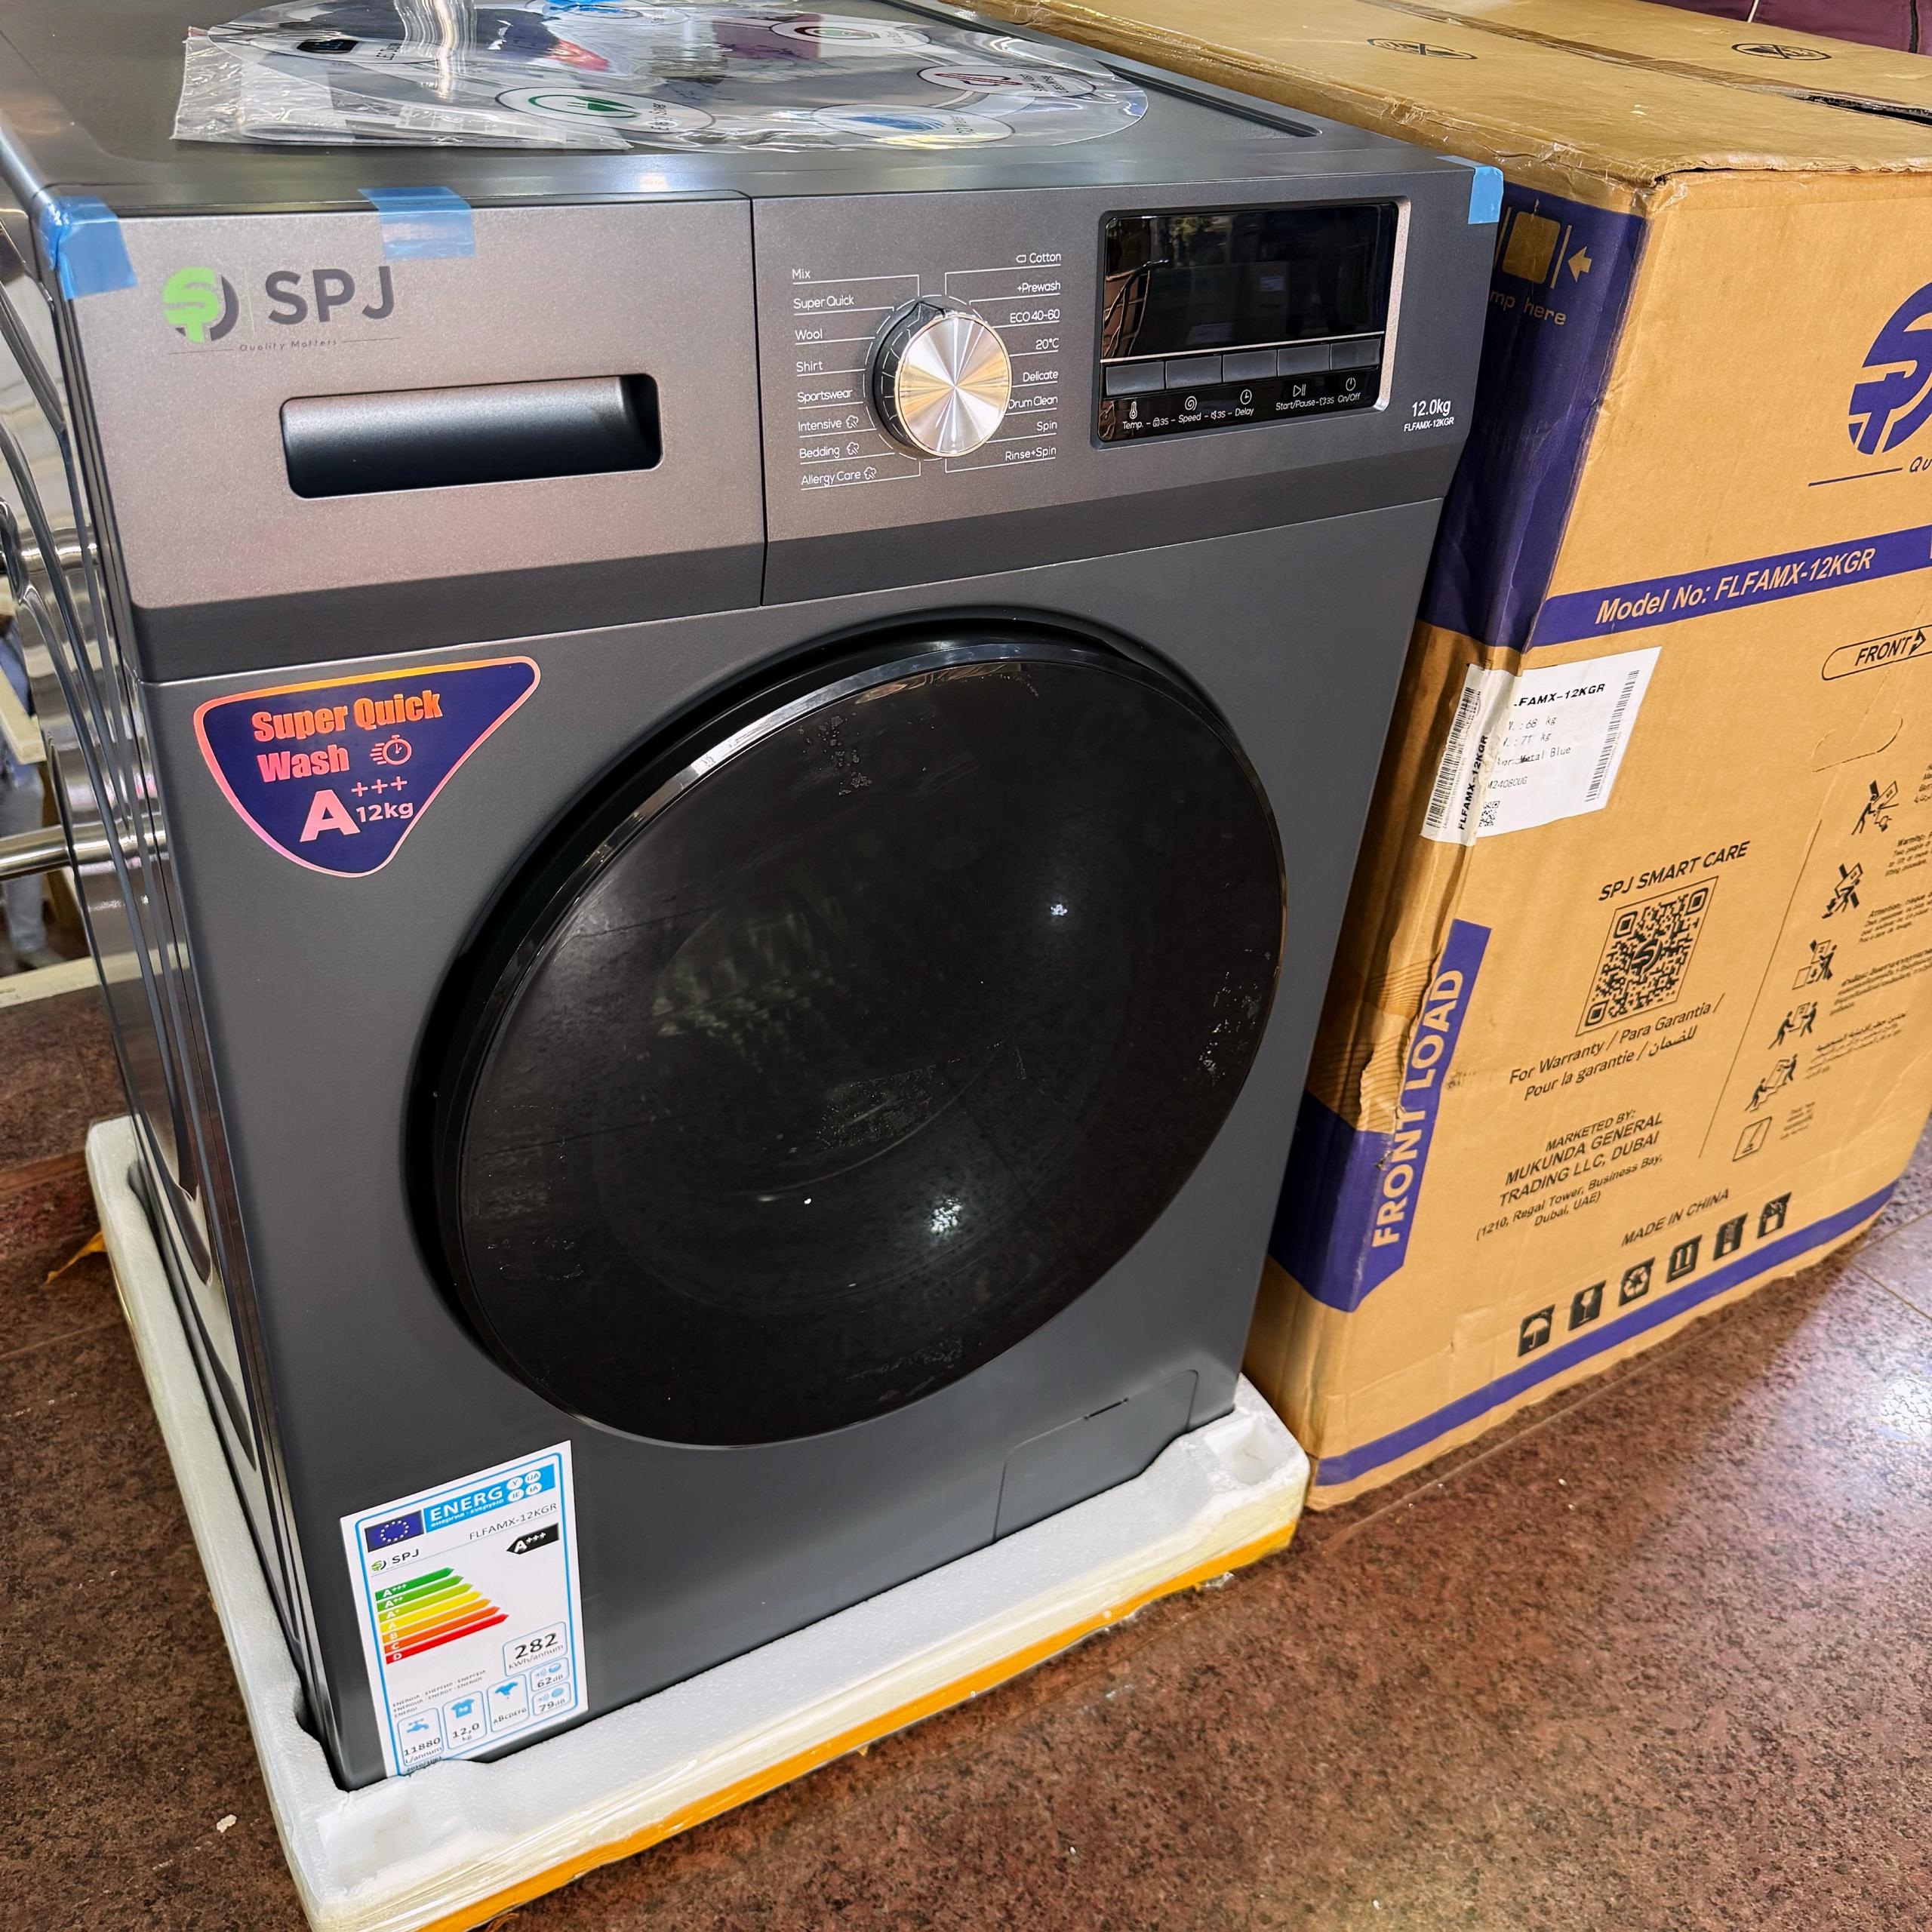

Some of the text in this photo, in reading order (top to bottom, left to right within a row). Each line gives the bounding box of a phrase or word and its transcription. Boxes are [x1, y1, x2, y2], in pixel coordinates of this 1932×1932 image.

[1029, 252, 1061, 263] Cotton
[792, 269, 811, 279] Mix
[265, 265, 395, 325] SPJ
[1017, 281, 1060, 293] +Prewash
[793, 294, 854, 312] Super Quick
[1524, 297, 1567, 326] here
[1010, 309, 1060, 324] ECO 40-60
[795, 328, 823, 340] Wool
[239, 339, 338, 352] Quality Matters
[1035, 338, 1060, 350] 20°C
[796, 361, 823, 373] Shirt
[1023, 371, 1059, 383] Delicate
[797, 389, 853, 405] Sportswear
[1008, 395, 1058, 410] Drum Clean
[1122, 420, 1144, 430] Temp.
[1178, 412, 1201, 424] Speed
[1235, 407, 1254, 417] Delay
[1337, 392, 1361, 405] On/Off
[1412, 399, 1451, 417] 12.0kg
[798, 417, 842, 432] Intensive
[1036, 421, 1057, 433] Spin
[1404, 417, 1454, 433] FLFAMX-12KGR
[799, 446, 840, 460] Bedding
[1005, 447, 1057, 461] Rinse+Spin
[801, 471, 861, 488] Allergy Care
[1595, 548, 1876, 625] Model No: FLFAMX-12KGR
[1854, 633, 1913, 667] FRONT
[1513, 683, 1606, 706] FAMX-12KGR
[251, 690, 443, 742] Super Quick
[1550, 746, 1571, 758] Blue
[257, 744, 349, 783] Wash
[1457, 735, 1488, 830] FLFAMX-12KGR
[356, 801, 414, 823] 12kg
[1598, 840, 1751, 902] SPJ SMART CARE
[1509, 1067, 1535, 1084] For
[1539, 1041, 1604, 1074] Warranty
[1619, 1023, 1651, 1044] Para
[1656, 1001, 1712, 1032] Garantia
[1524, 1078, 1558, 1100] Pour
[1561, 1070, 1574, 1087] la
[1576, 1050, 1635, 1084] garantie
[1371, 969, 1463, 1247] FRONT LOAD
[1546, 1109, 1636, 1152] MARKETED BY:
[1505, 1112, 1663, 1186] MUKUNDA GENERAL
[1500, 1131, 1660, 1207] TRADING LLC, DUBAI
[1476, 1219, 1509, 1241] (1210,
[1512, 1201, 1546, 1223] Regal
[1549, 1186, 1584, 1209] Tower,
[1587, 1163, 1638, 1190] Business
[1534, 1190, 1601, 1227] Dubai, UAE)
[1621, 1189, 1730, 1247] MADE IN CHINA
[430, 1486, 503, 1522] ENERG
[469, 1503, 558, 1540] FLFAMX-12KGR
[392, 1549, 420, 1564] SPJ
[388, 1622, 397, 1630] A
[389, 1632, 398, 1640] B
[391, 1641, 400, 1651] C
[515, 1632, 558, 1660] 282
[392, 1652, 402, 1661] D
[405, 1737, 441, 1756] 11880
